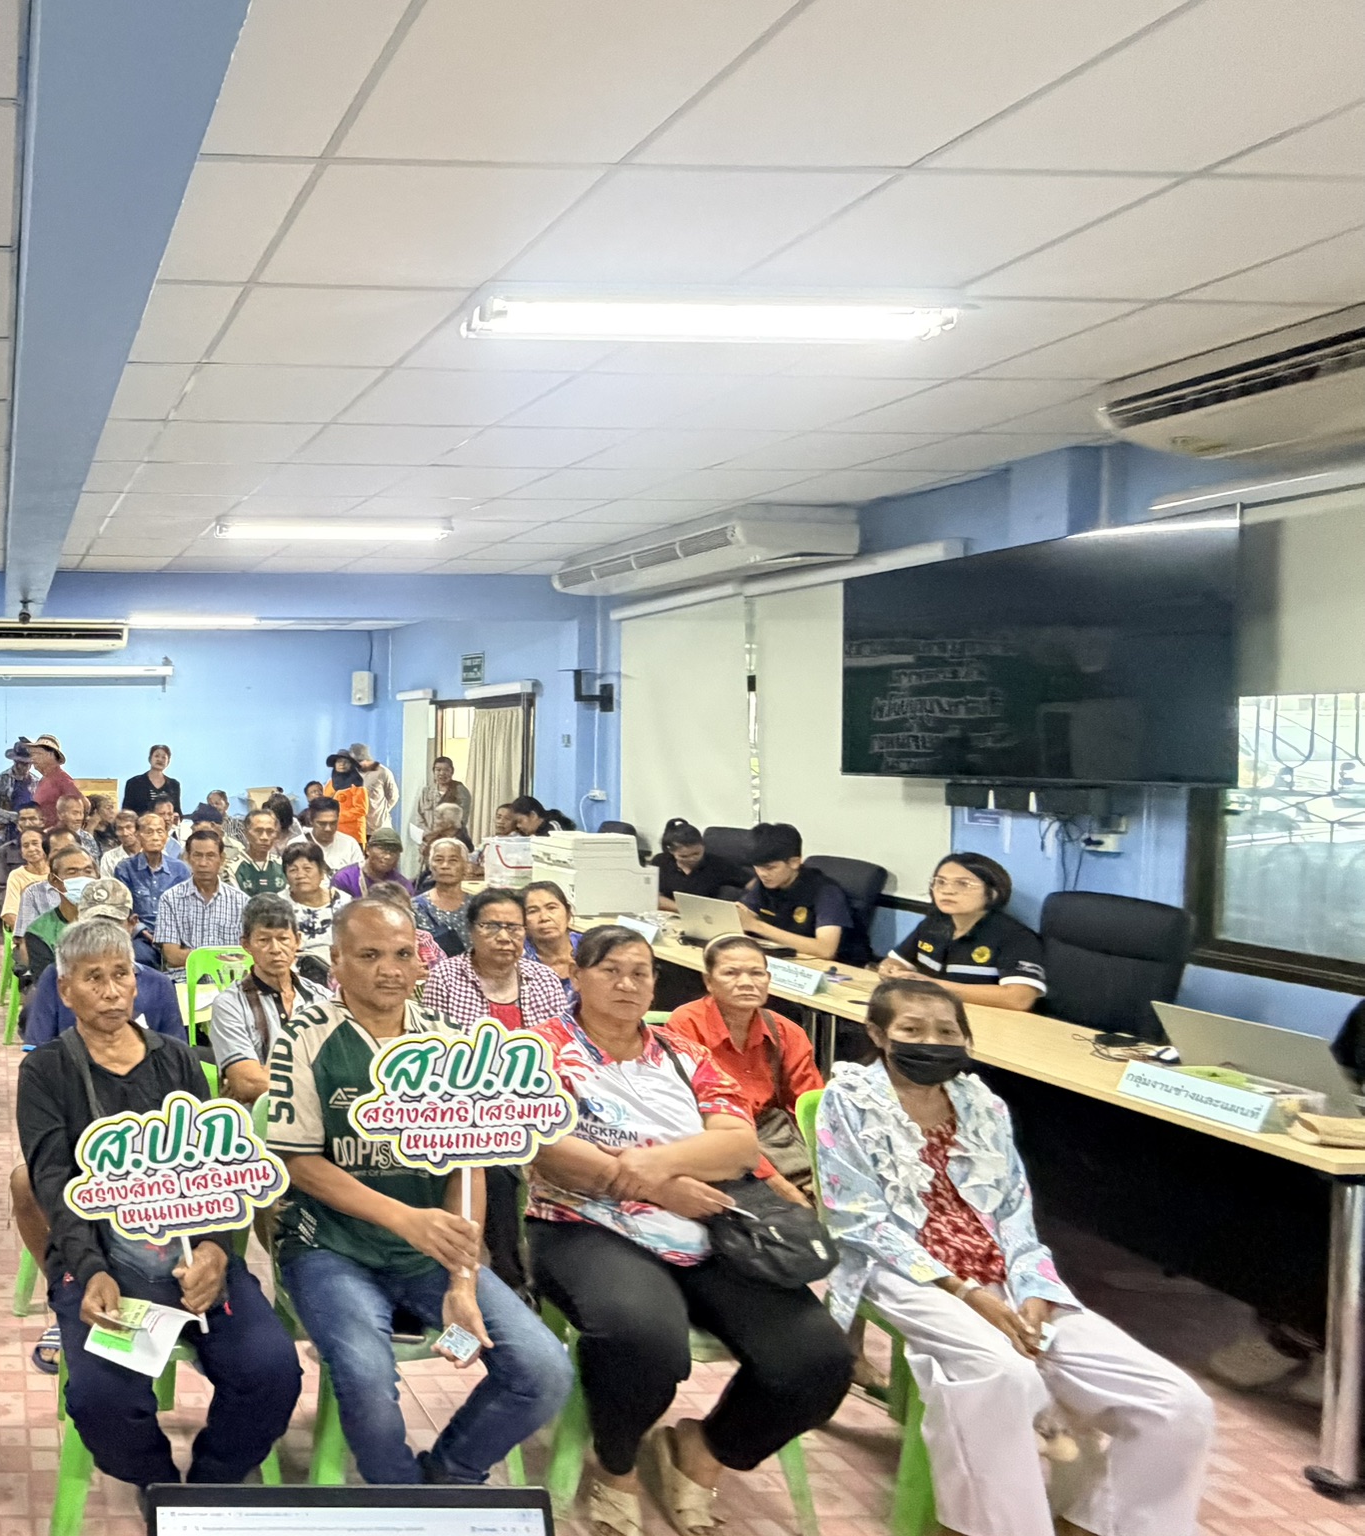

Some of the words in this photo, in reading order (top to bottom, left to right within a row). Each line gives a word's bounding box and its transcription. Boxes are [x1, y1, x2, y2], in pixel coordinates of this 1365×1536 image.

[385, 1031, 545, 1092] ส.ป.ก.
[363, 1101, 470, 1124] สร้างสิทธิ
[479, 1099, 562, 1128] เสริมทุน
[88, 1105, 247, 1172] ส.ป.ก.
[405, 1131, 522, 1157] หนุนเกษตร
[77, 1174, 176, 1205] สร้างสิทธิ
[185, 1164, 271, 1192] เสริมทุน
[121, 1196, 235, 1229] หนุนเกษตร
